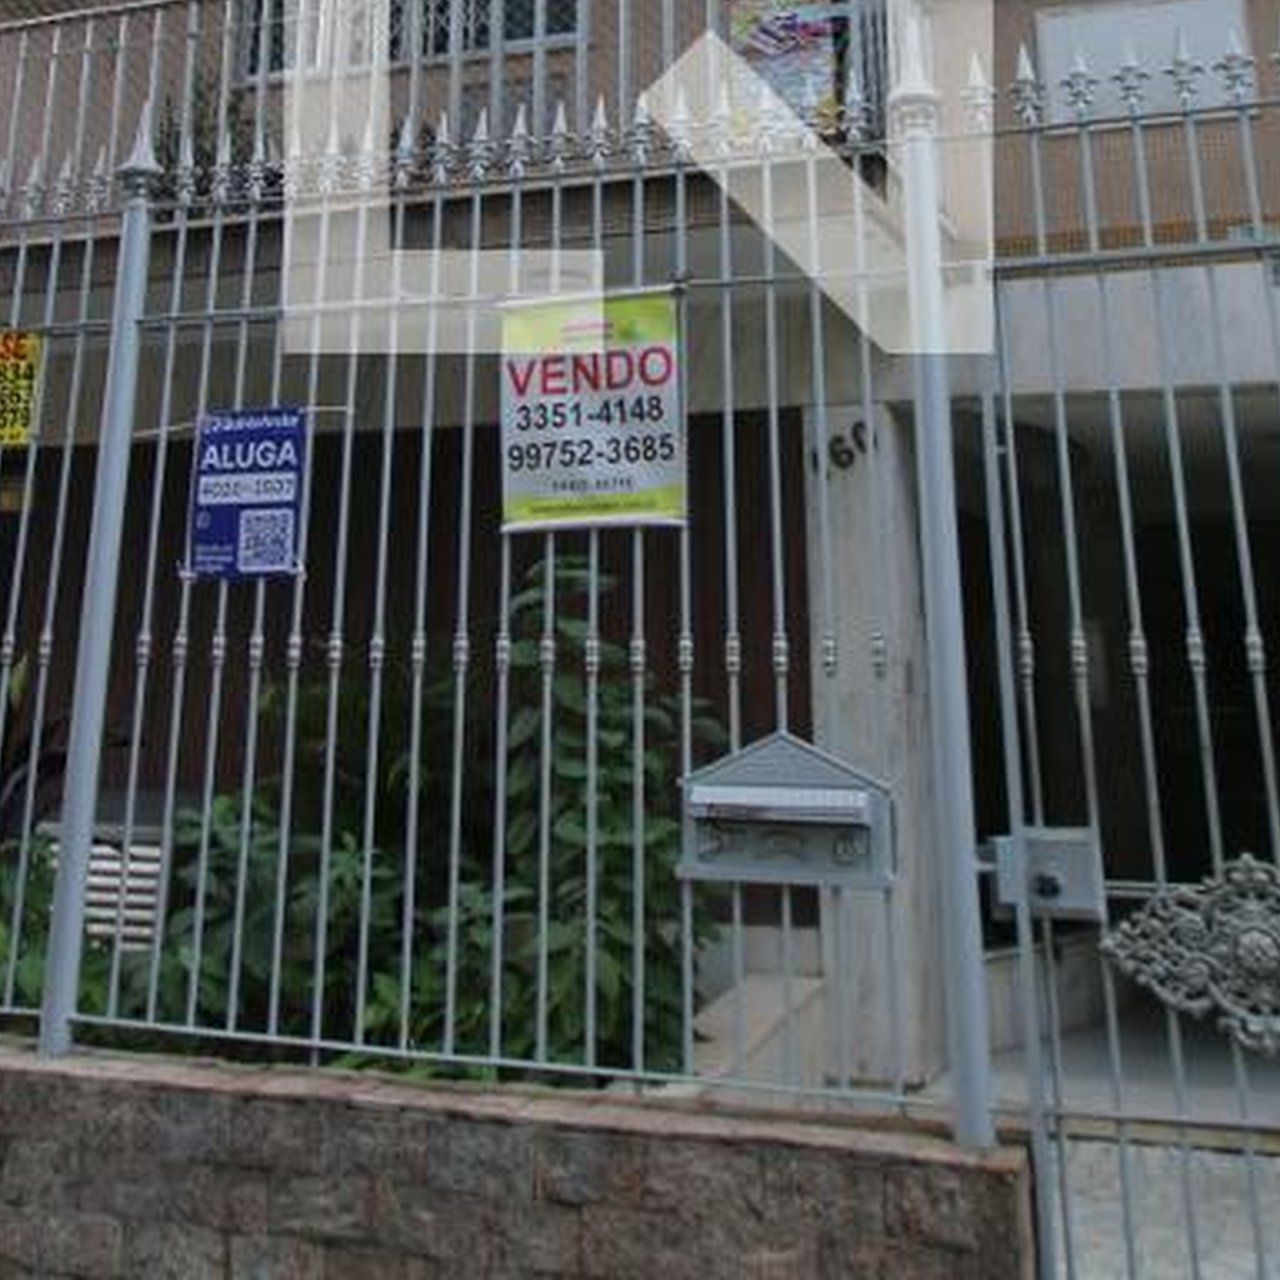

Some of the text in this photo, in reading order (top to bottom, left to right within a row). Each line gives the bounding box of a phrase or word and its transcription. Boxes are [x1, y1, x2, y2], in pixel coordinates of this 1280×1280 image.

[506, 346, 673, 397] VENDO
[515, 396, 665, 432] 3351-4148
[200, 440, 299, 470] ALUGA
[508, 433, 676, 472] 99752-3685
